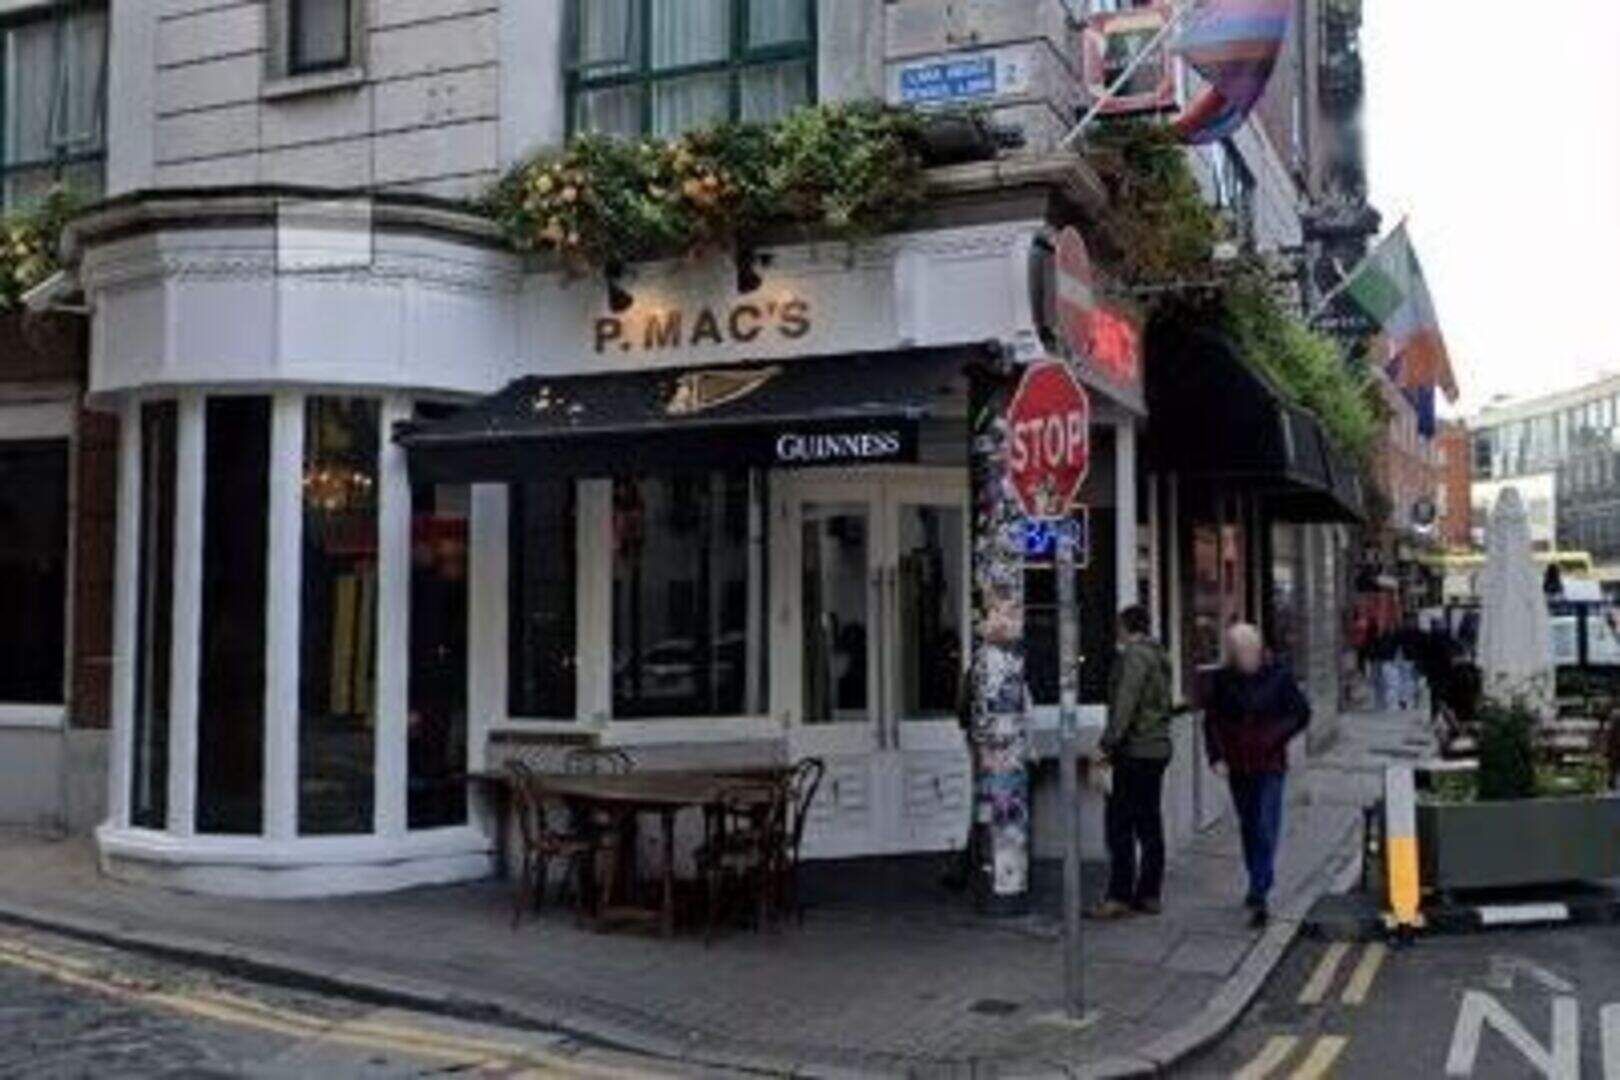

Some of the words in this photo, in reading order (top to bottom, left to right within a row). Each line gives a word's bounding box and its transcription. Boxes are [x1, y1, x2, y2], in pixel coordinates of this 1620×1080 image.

[594, 318, 630, 354] P.
[643, 300, 811, 347] MAC'S
[776, 430, 900, 461] GUINNESS
[1013, 412, 1083, 471] STOP
[1446, 989, 1620, 1080] N
